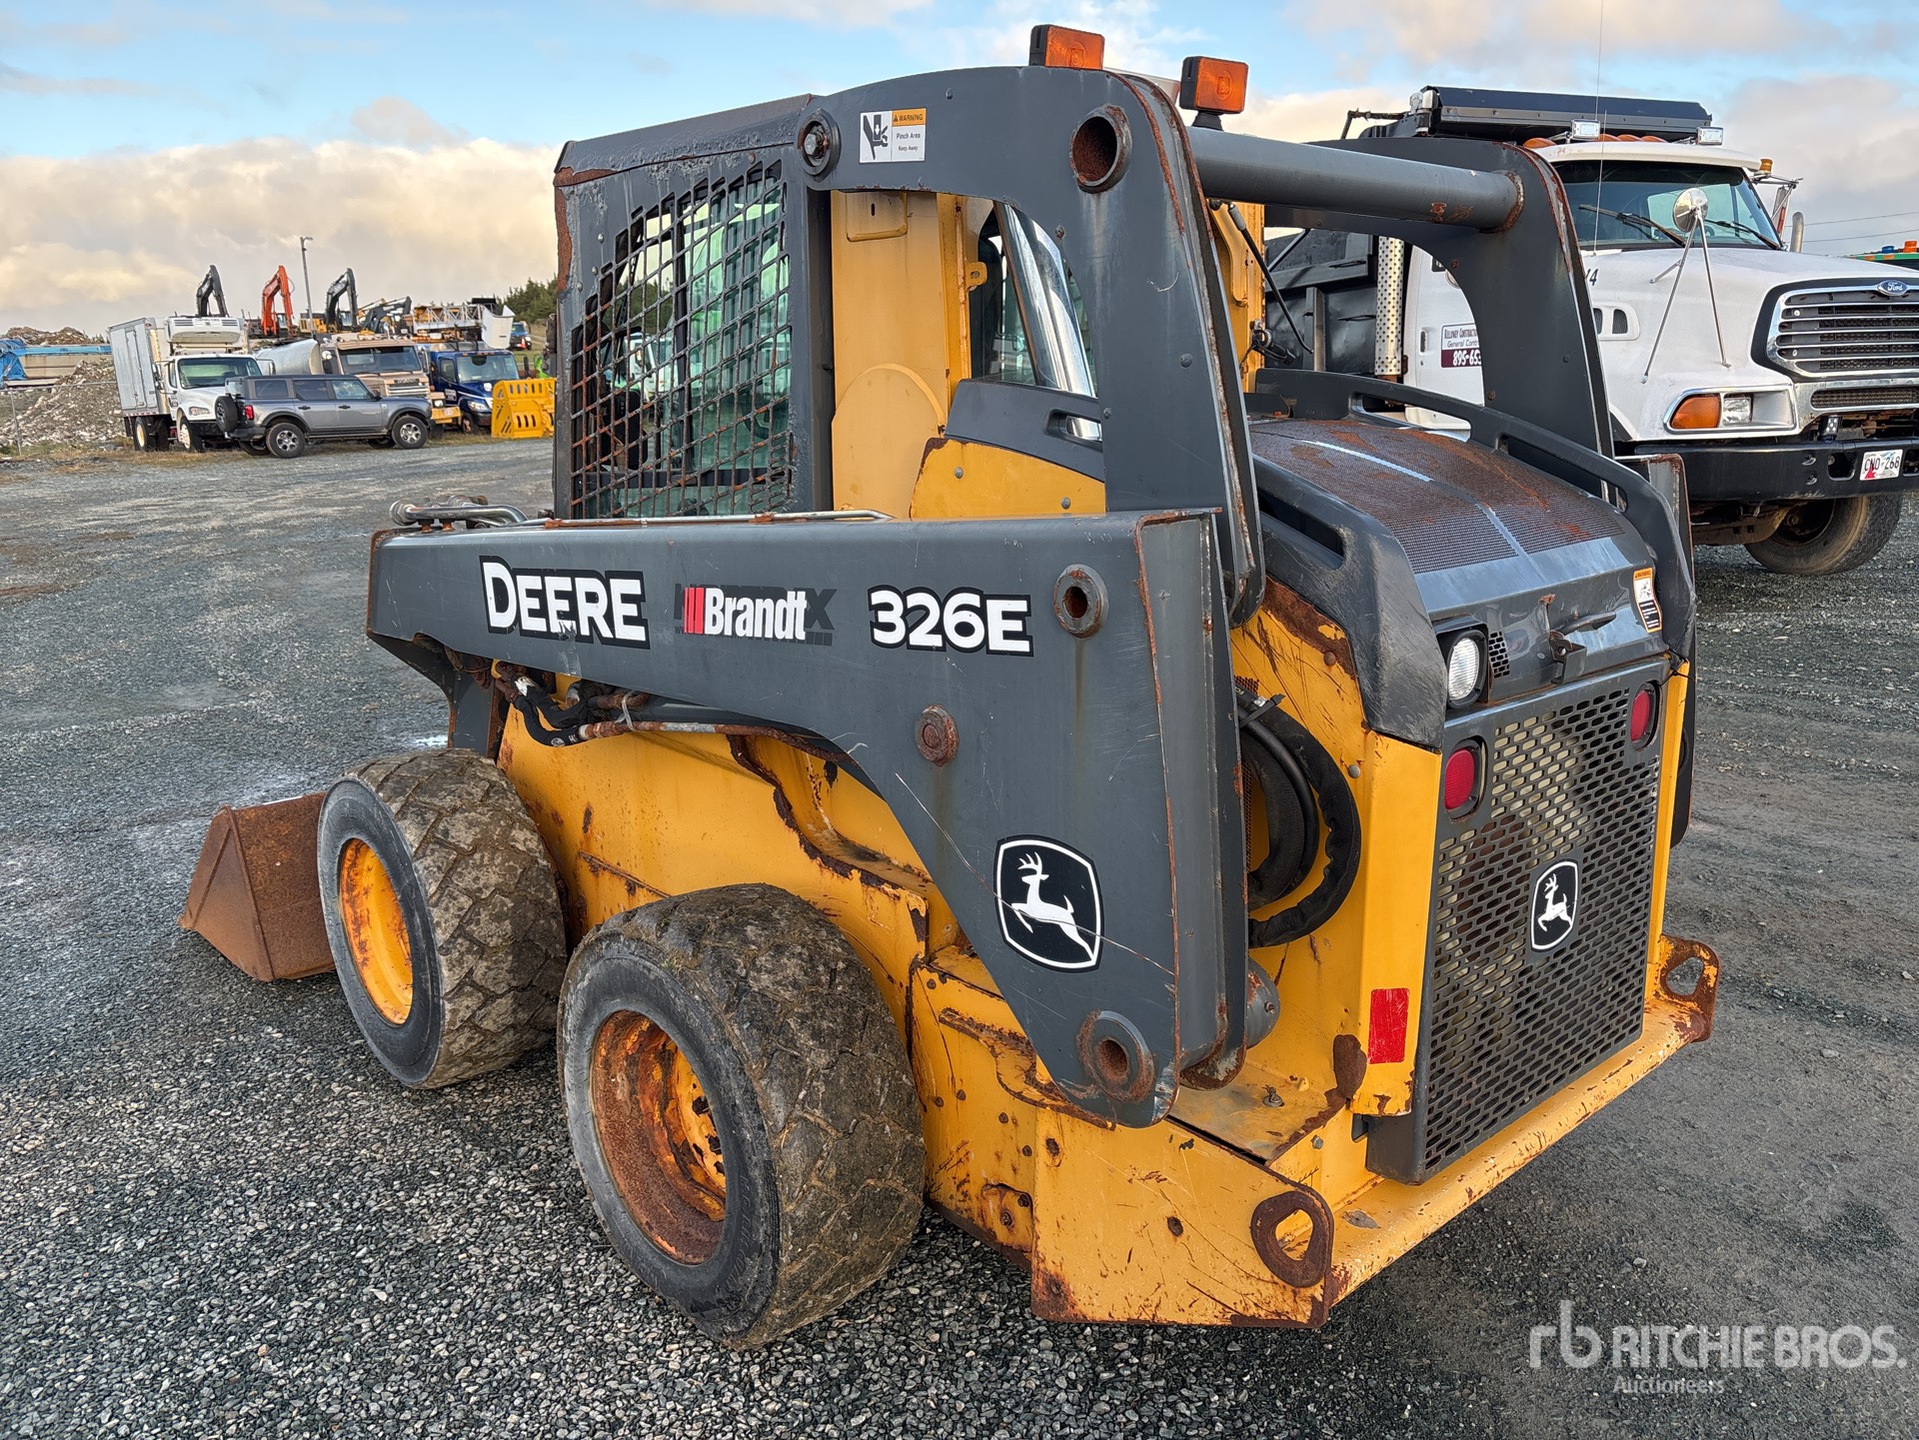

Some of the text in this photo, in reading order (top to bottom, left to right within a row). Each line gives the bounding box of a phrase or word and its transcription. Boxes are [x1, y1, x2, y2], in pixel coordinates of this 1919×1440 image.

[899, 114, 923, 122] WARNING
[1887, 282, 1903, 291] Ford
[482, 561, 647, 642] DEERE
[704, 587, 808, 641] Brandt
[870, 589, 1031, 653] 326E
